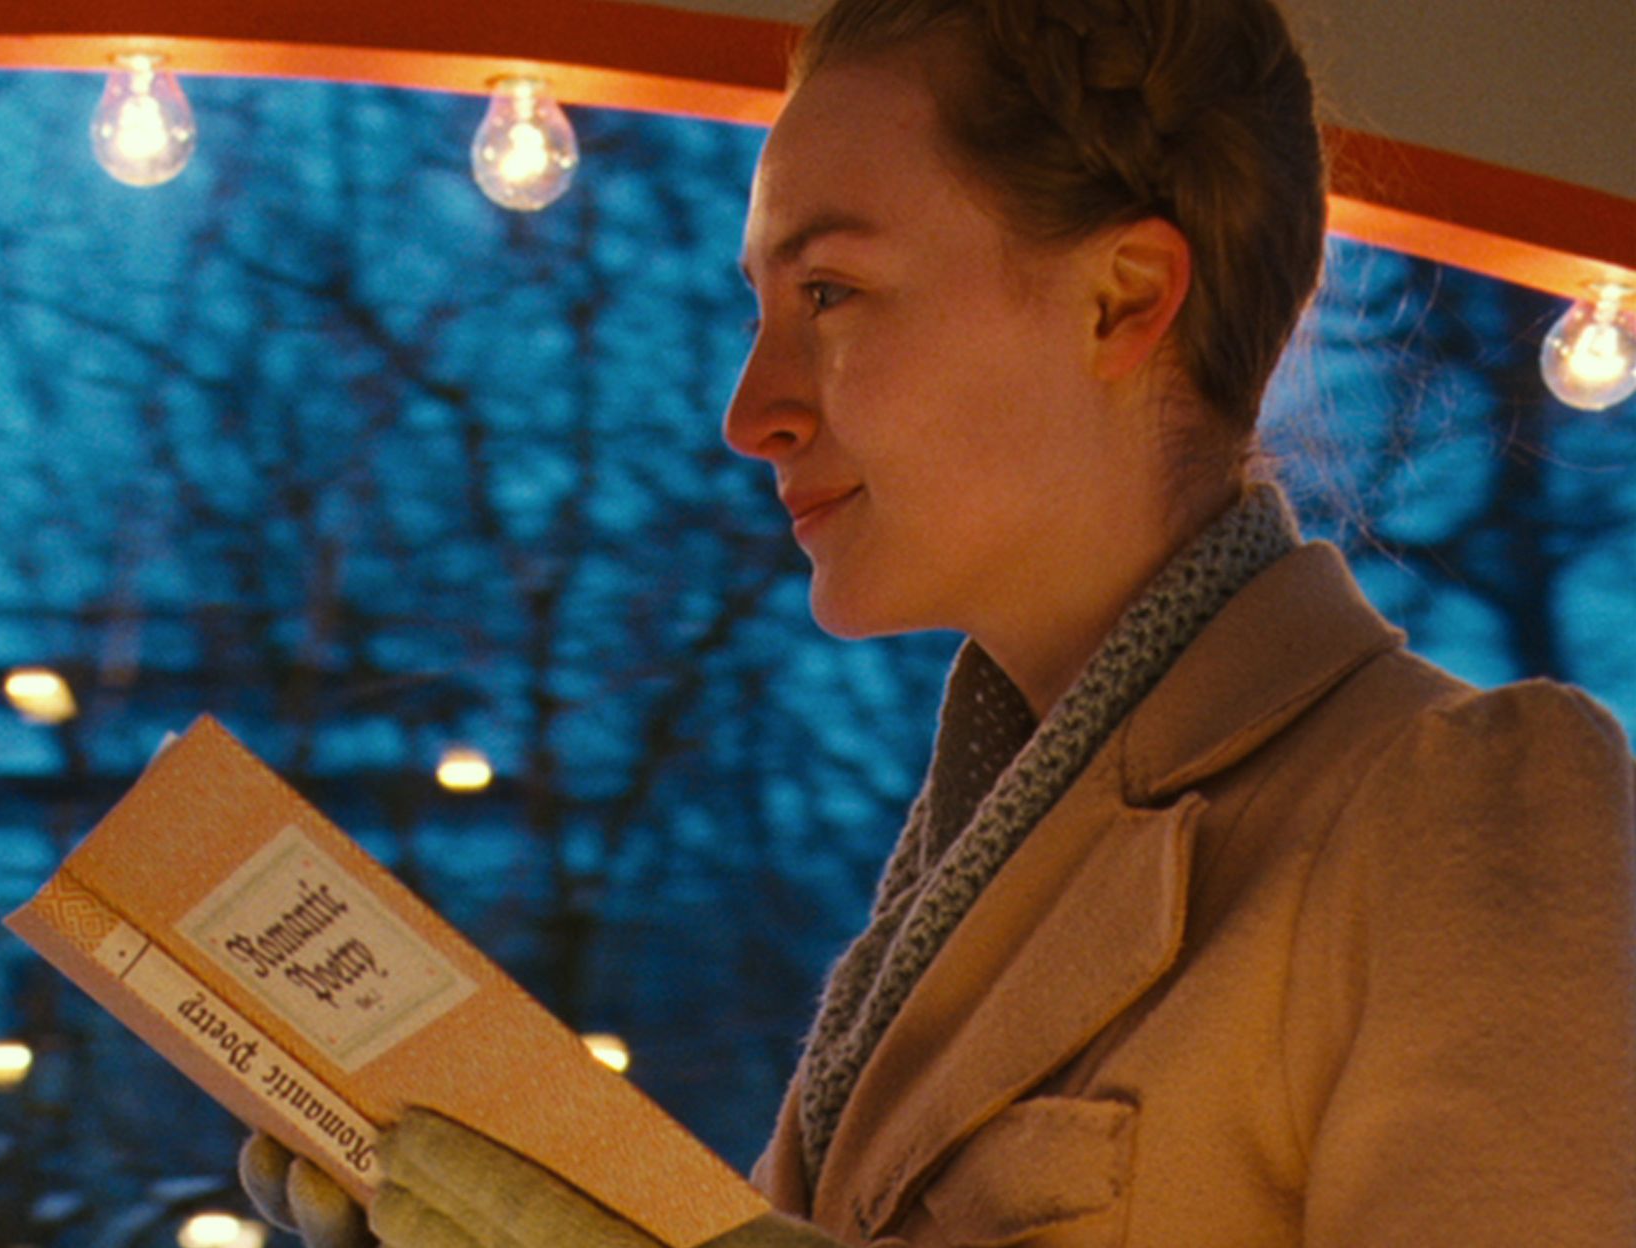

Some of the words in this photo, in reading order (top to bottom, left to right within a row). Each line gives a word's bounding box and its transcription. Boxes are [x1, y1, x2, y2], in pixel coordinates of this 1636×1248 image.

[224, 878, 349, 979] Romantic
[284, 937, 389, 1009] Poetry
[176, 990, 259, 1074] Poetry
[261, 1063, 375, 1174] Romantic
